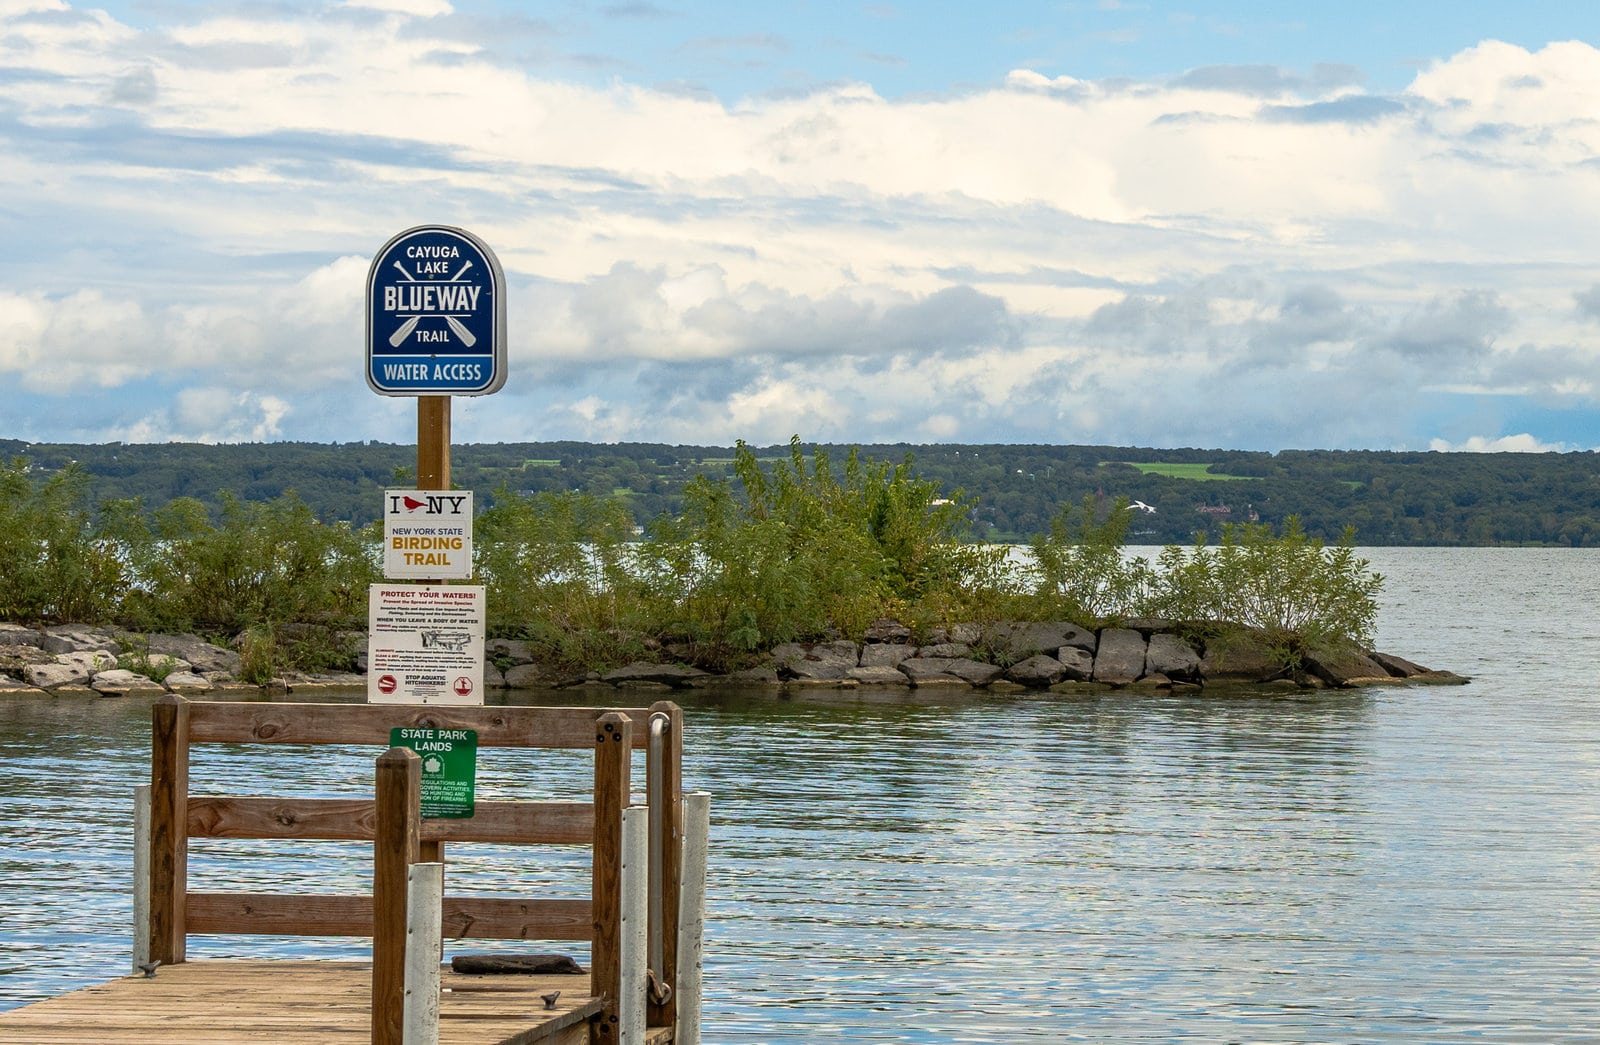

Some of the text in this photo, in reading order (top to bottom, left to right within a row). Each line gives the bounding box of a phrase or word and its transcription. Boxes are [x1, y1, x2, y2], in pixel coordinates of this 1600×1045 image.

[406, 246, 460, 258] CAYUGA
[417, 262, 449, 274] LAKE
[384, 286, 482, 311] BLUEWAY
[416, 330, 450, 342] TRAIL
[384, 364, 481, 381] WATER ACCESS
[390, 496, 466, 514] I NY
[392, 537, 463, 550] BIRDING
[403, 553, 451, 566] TRAIL
[401, 728, 467, 740] STATE PARK
[415, 741, 452, 752] LANDS
